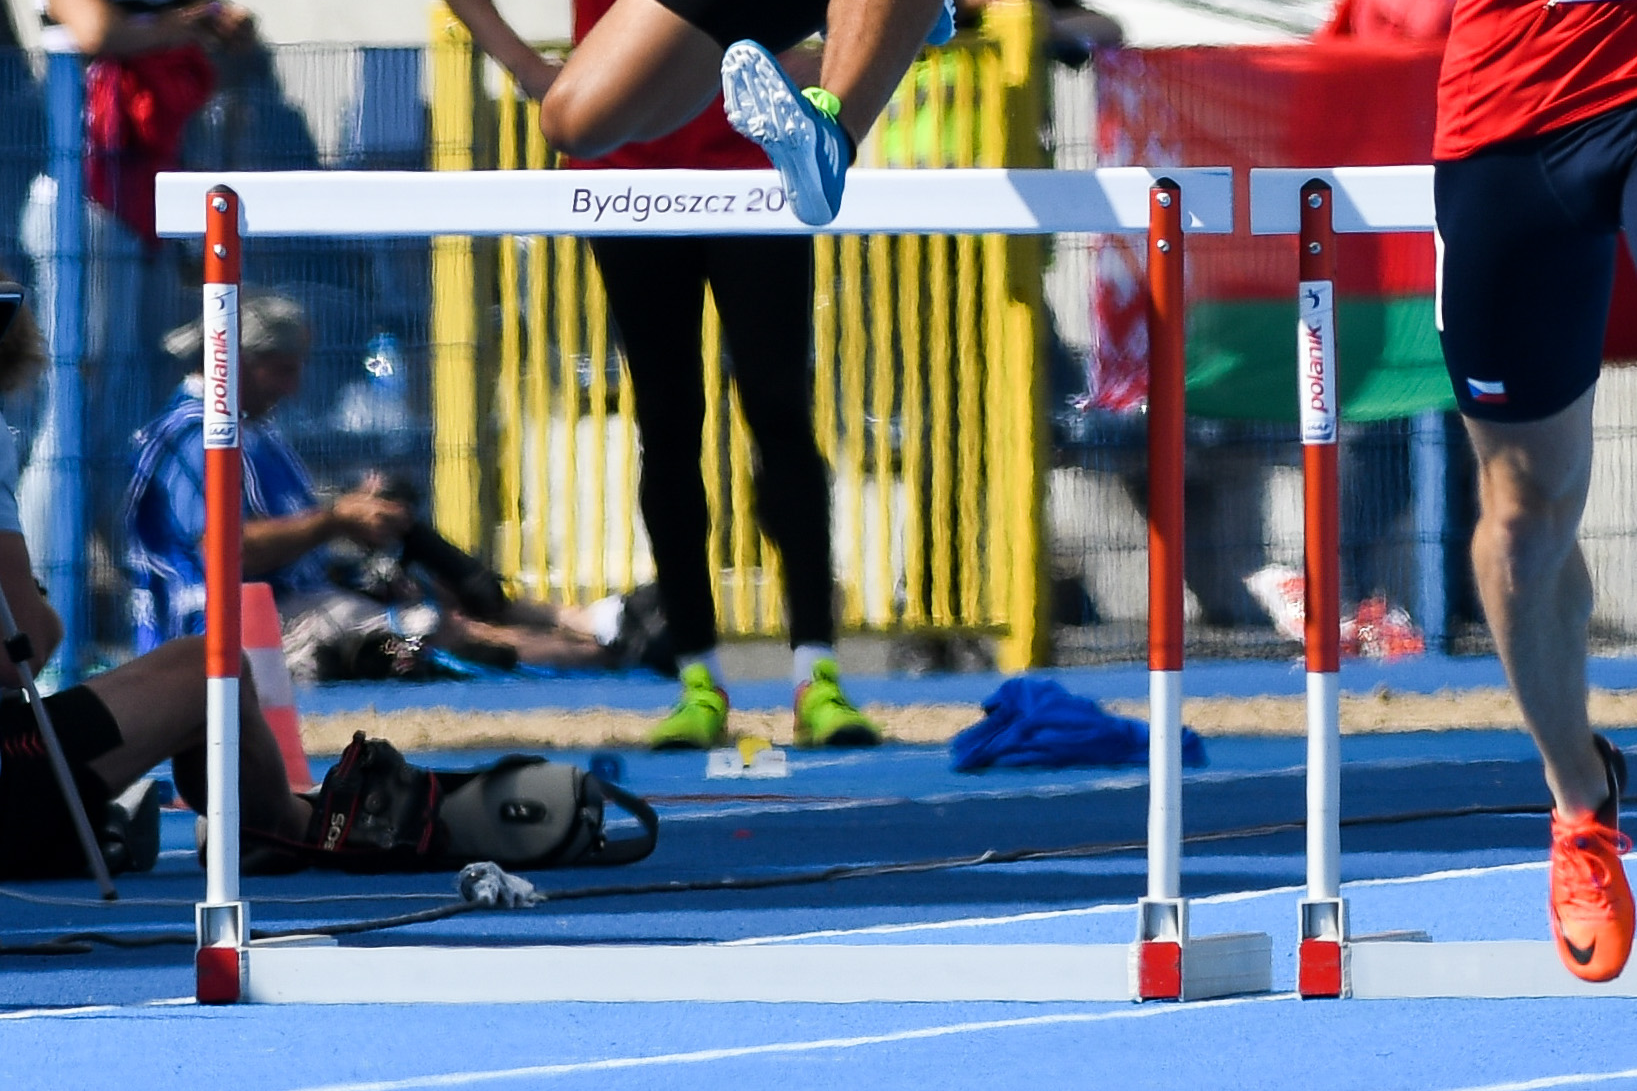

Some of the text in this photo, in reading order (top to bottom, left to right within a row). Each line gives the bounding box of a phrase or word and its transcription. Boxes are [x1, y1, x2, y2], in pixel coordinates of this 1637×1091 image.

[572, 186, 786, 222] Bydgoszcz 20
[210, 328, 232, 417] polanik
[1306, 323, 1327, 413] polanik
